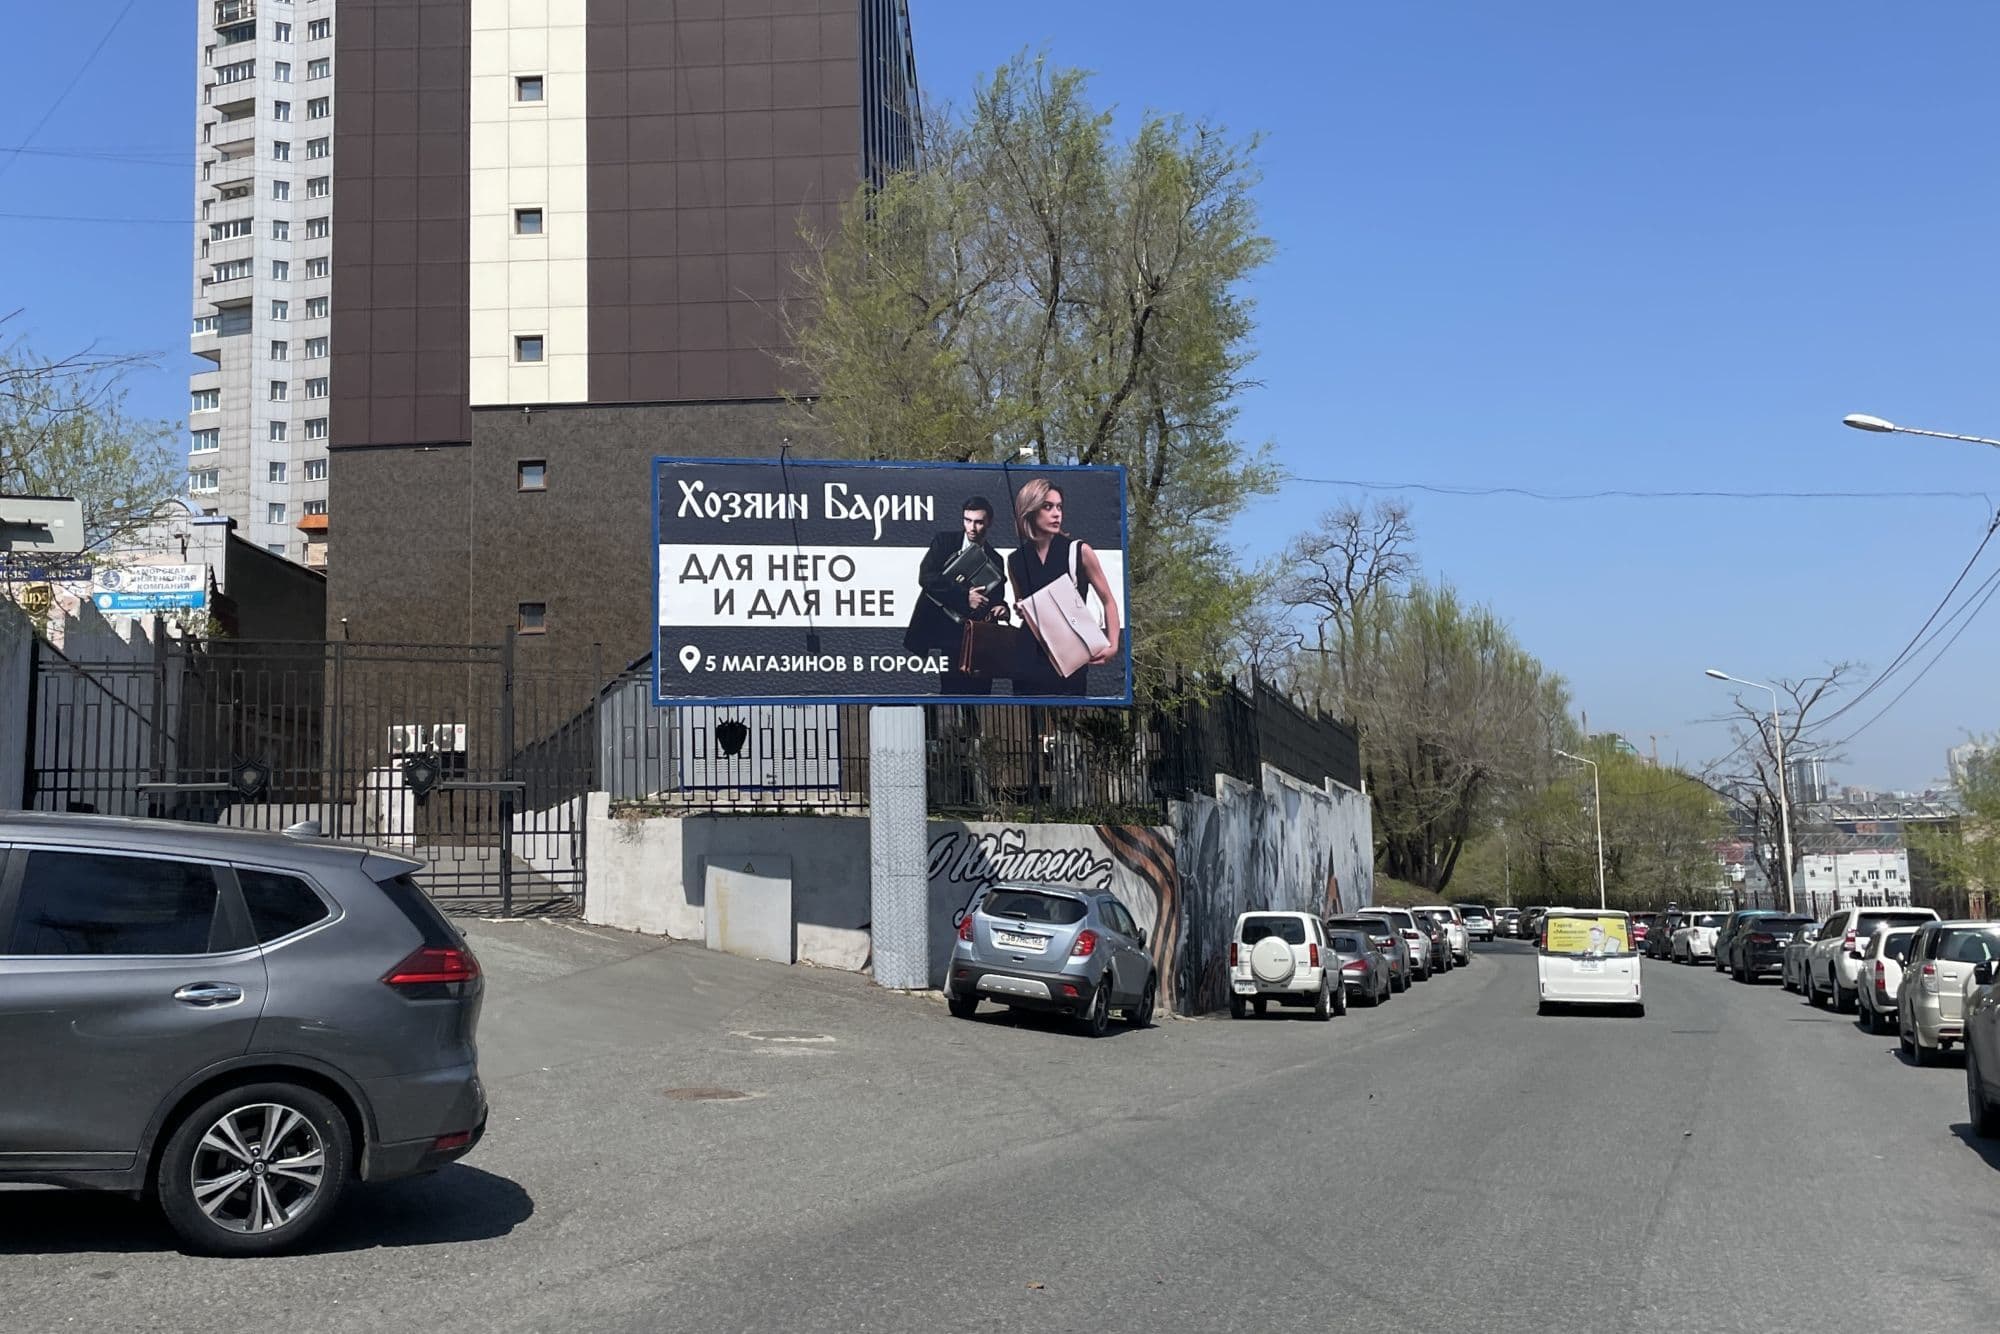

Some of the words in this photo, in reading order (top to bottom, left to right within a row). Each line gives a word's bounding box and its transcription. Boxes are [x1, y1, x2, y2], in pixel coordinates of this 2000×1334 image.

[678, 480, 808, 522] Хозяин
[824, 483, 934, 540] Барин
[679, 554, 753, 583] ДЛЯ
[769, 554, 856, 582] НЕГО
[137, 582, 190, 590] КОМПАНИЯ
[714, 589, 735, 615] И
[747, 590, 821, 619] ДЛЯ
[836, 591, 894, 617] НЕЕ
[705, 656, 717, 672] 5
[723, 656, 847, 672] МАГАЗИНОВ
[853, 656, 864, 673] В
[870, 656, 949, 674] ГОРОДЕ
